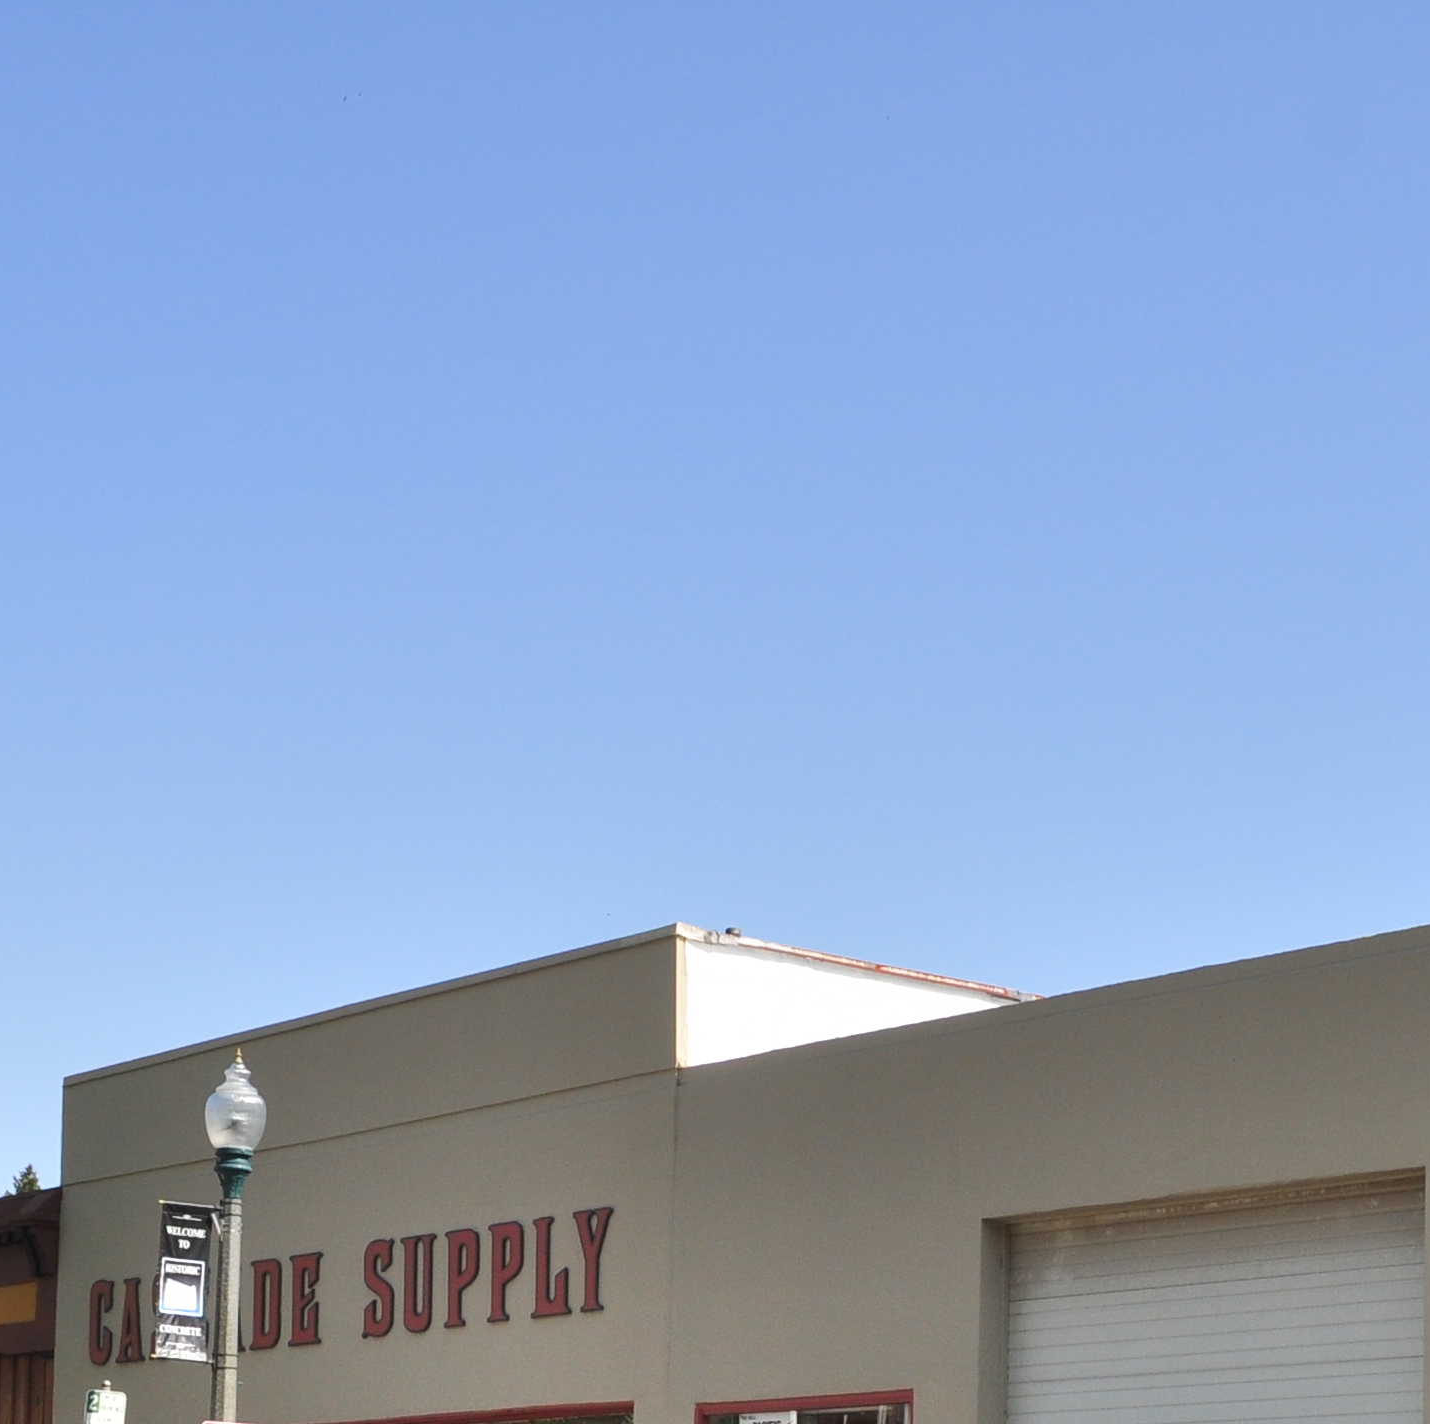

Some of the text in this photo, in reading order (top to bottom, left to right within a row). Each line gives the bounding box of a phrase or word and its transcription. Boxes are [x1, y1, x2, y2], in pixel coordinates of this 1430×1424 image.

[166, 1225, 206, 1239] WELCOME
[178, 1239, 191, 1249] TO
[165, 1263, 201, 1276] HISTORIC
[89, 1206, 614, 1366] CADE SUPPLY
[159, 1324, 202, 1337] CONCRETE
[88, 1392, 99, 1411] 2
